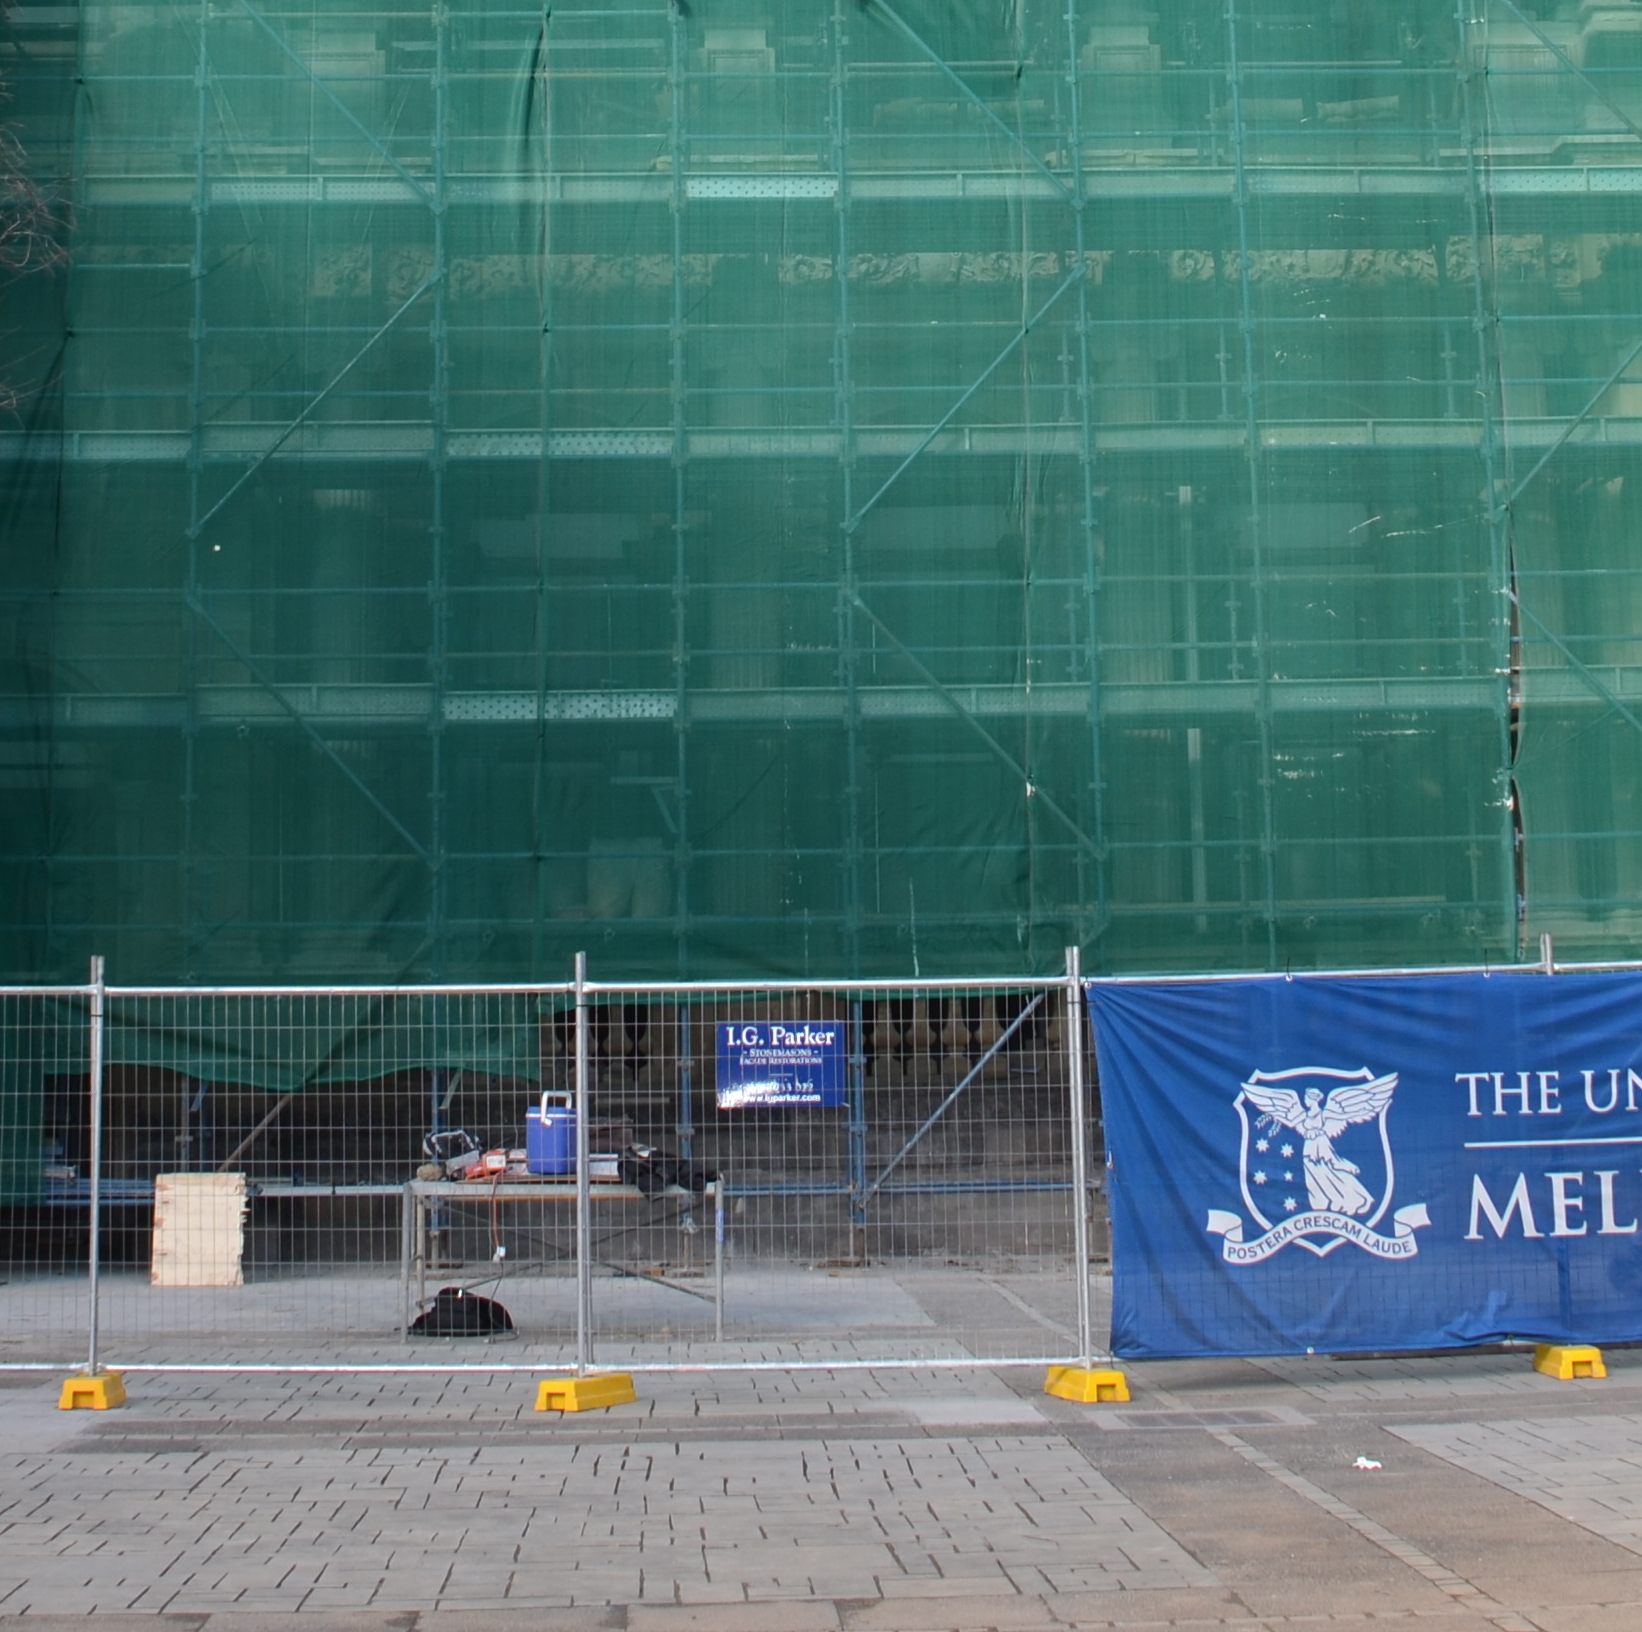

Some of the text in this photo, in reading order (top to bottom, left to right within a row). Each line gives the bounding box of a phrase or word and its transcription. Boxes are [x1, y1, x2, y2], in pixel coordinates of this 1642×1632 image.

[726, 1025, 835, 1045] I.G. Parker
[1454, 1071, 1563, 1116] THE
[1226, 1215, 1412, 1260] POSTERA CRESCAM LAUDE
